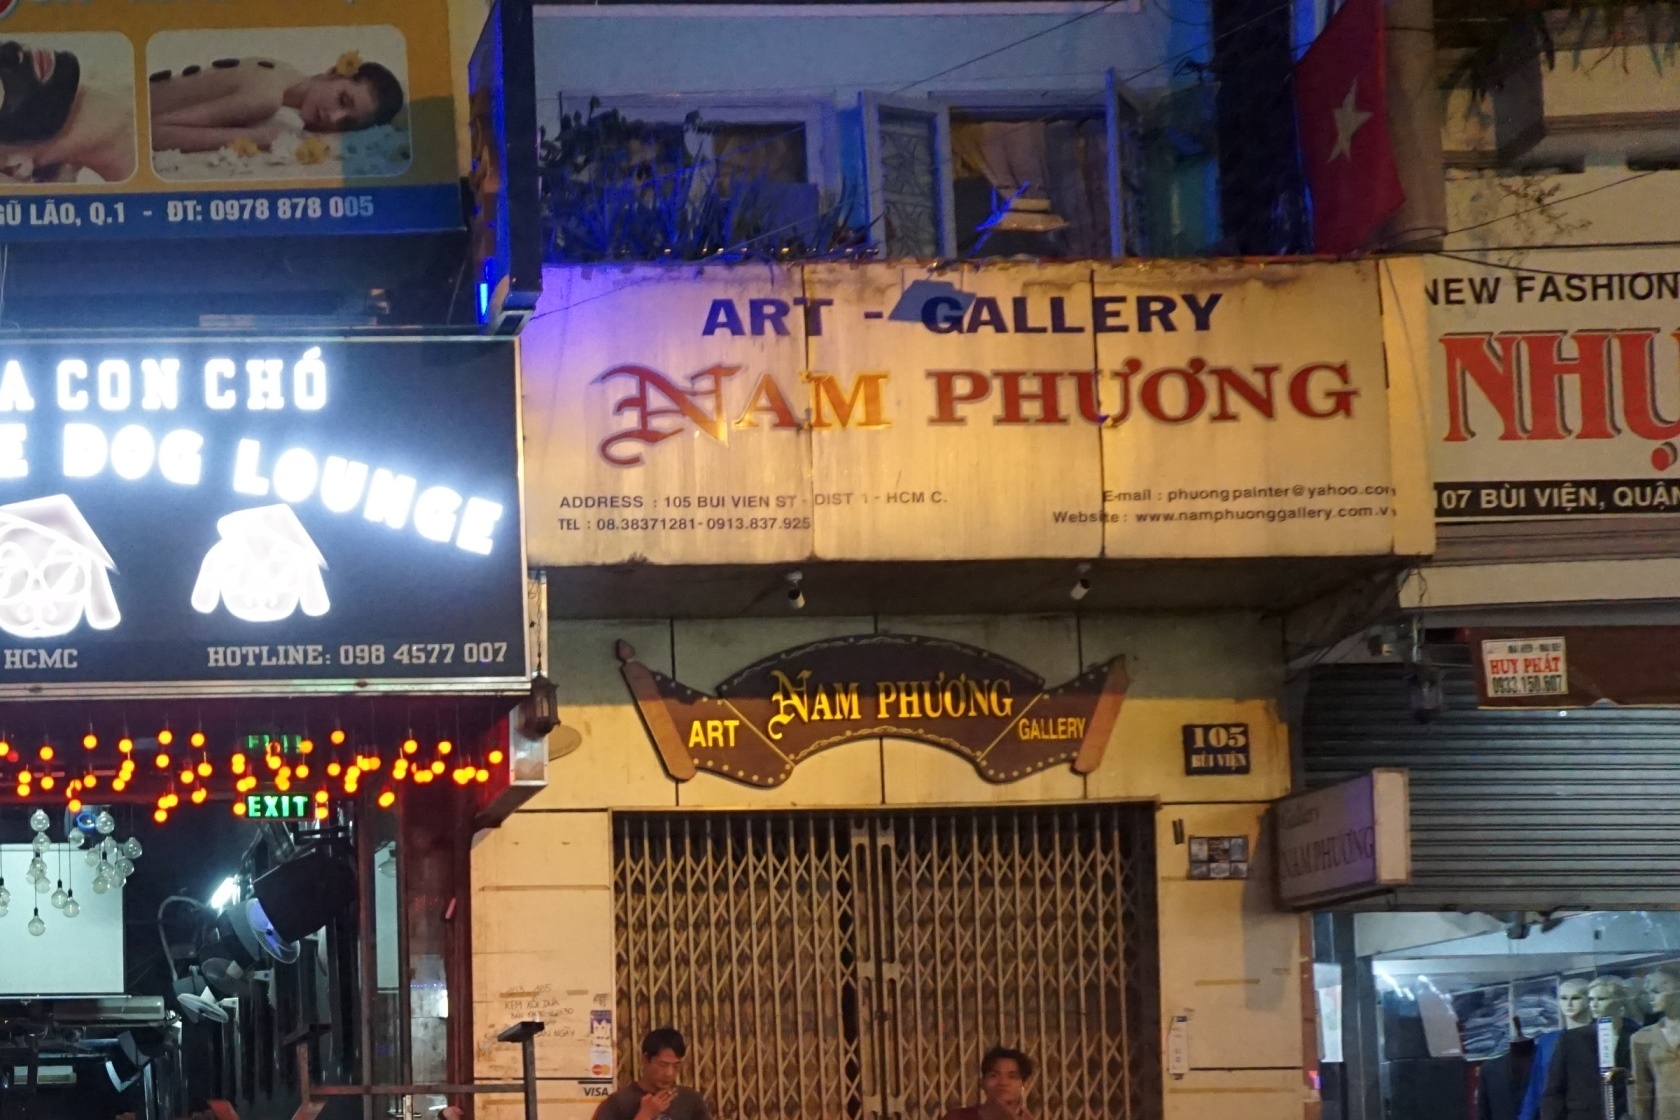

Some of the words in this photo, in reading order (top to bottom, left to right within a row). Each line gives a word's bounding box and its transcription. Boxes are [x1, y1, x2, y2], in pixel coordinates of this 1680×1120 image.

[30, 199, 81, 227] LÃO,
[89, 201, 125, 226] Q.1
[167, 199, 203, 222] ĐT:
[210, 198, 269, 222] 0978
[277, 196, 321, 220] 878
[329, 195, 374, 219] 005
[1516, 272, 1680, 304] FASHION
[701, 297, 835, 338] ART
[920, 291, 1224, 336] GALLERY
[56, 356, 180, 411] CON
[204, 346, 328, 411] CHÓ
[591, 361, 893, 467] NAM
[926, 357, 1361, 428] PHƯƠNG
[62, 421, 205, 486] DOG
[233, 438, 504, 556] LOUNGE
[560, 495, 644, 508] ADDRESS
[664, 496, 691, 508] 105
[697, 495, 726, 508] BUI
[731, 495, 770, 508] VIEN
[776, 494, 798, 507] ST
[814, 492, 852, 506] DIST
[886, 491, 925, 504] HCM
[1104, 490, 1151, 502] E-mail
[1480, 483, 1527, 509] BÙI
[1534, 482, 1606, 511] VIỆN,
[558, 518, 581, 530] TEL
[4, 648, 78, 670] HCMC
[207, 644, 332, 667] HOTLINE:
[339, 643, 385, 666] 098
[392, 642, 459, 665] 4577
[463, 641, 507, 663] 007
[767, 669, 863, 741] NAM
[876, 673, 1014, 720] PHƯƠNG
[688, 718, 740, 748] ART
[1018, 716, 1087, 741] GALLERY
[1191, 727, 1247, 749] 105
[247, 795, 309, 817] EXIT
[582, 1086, 609, 1097] VISA
